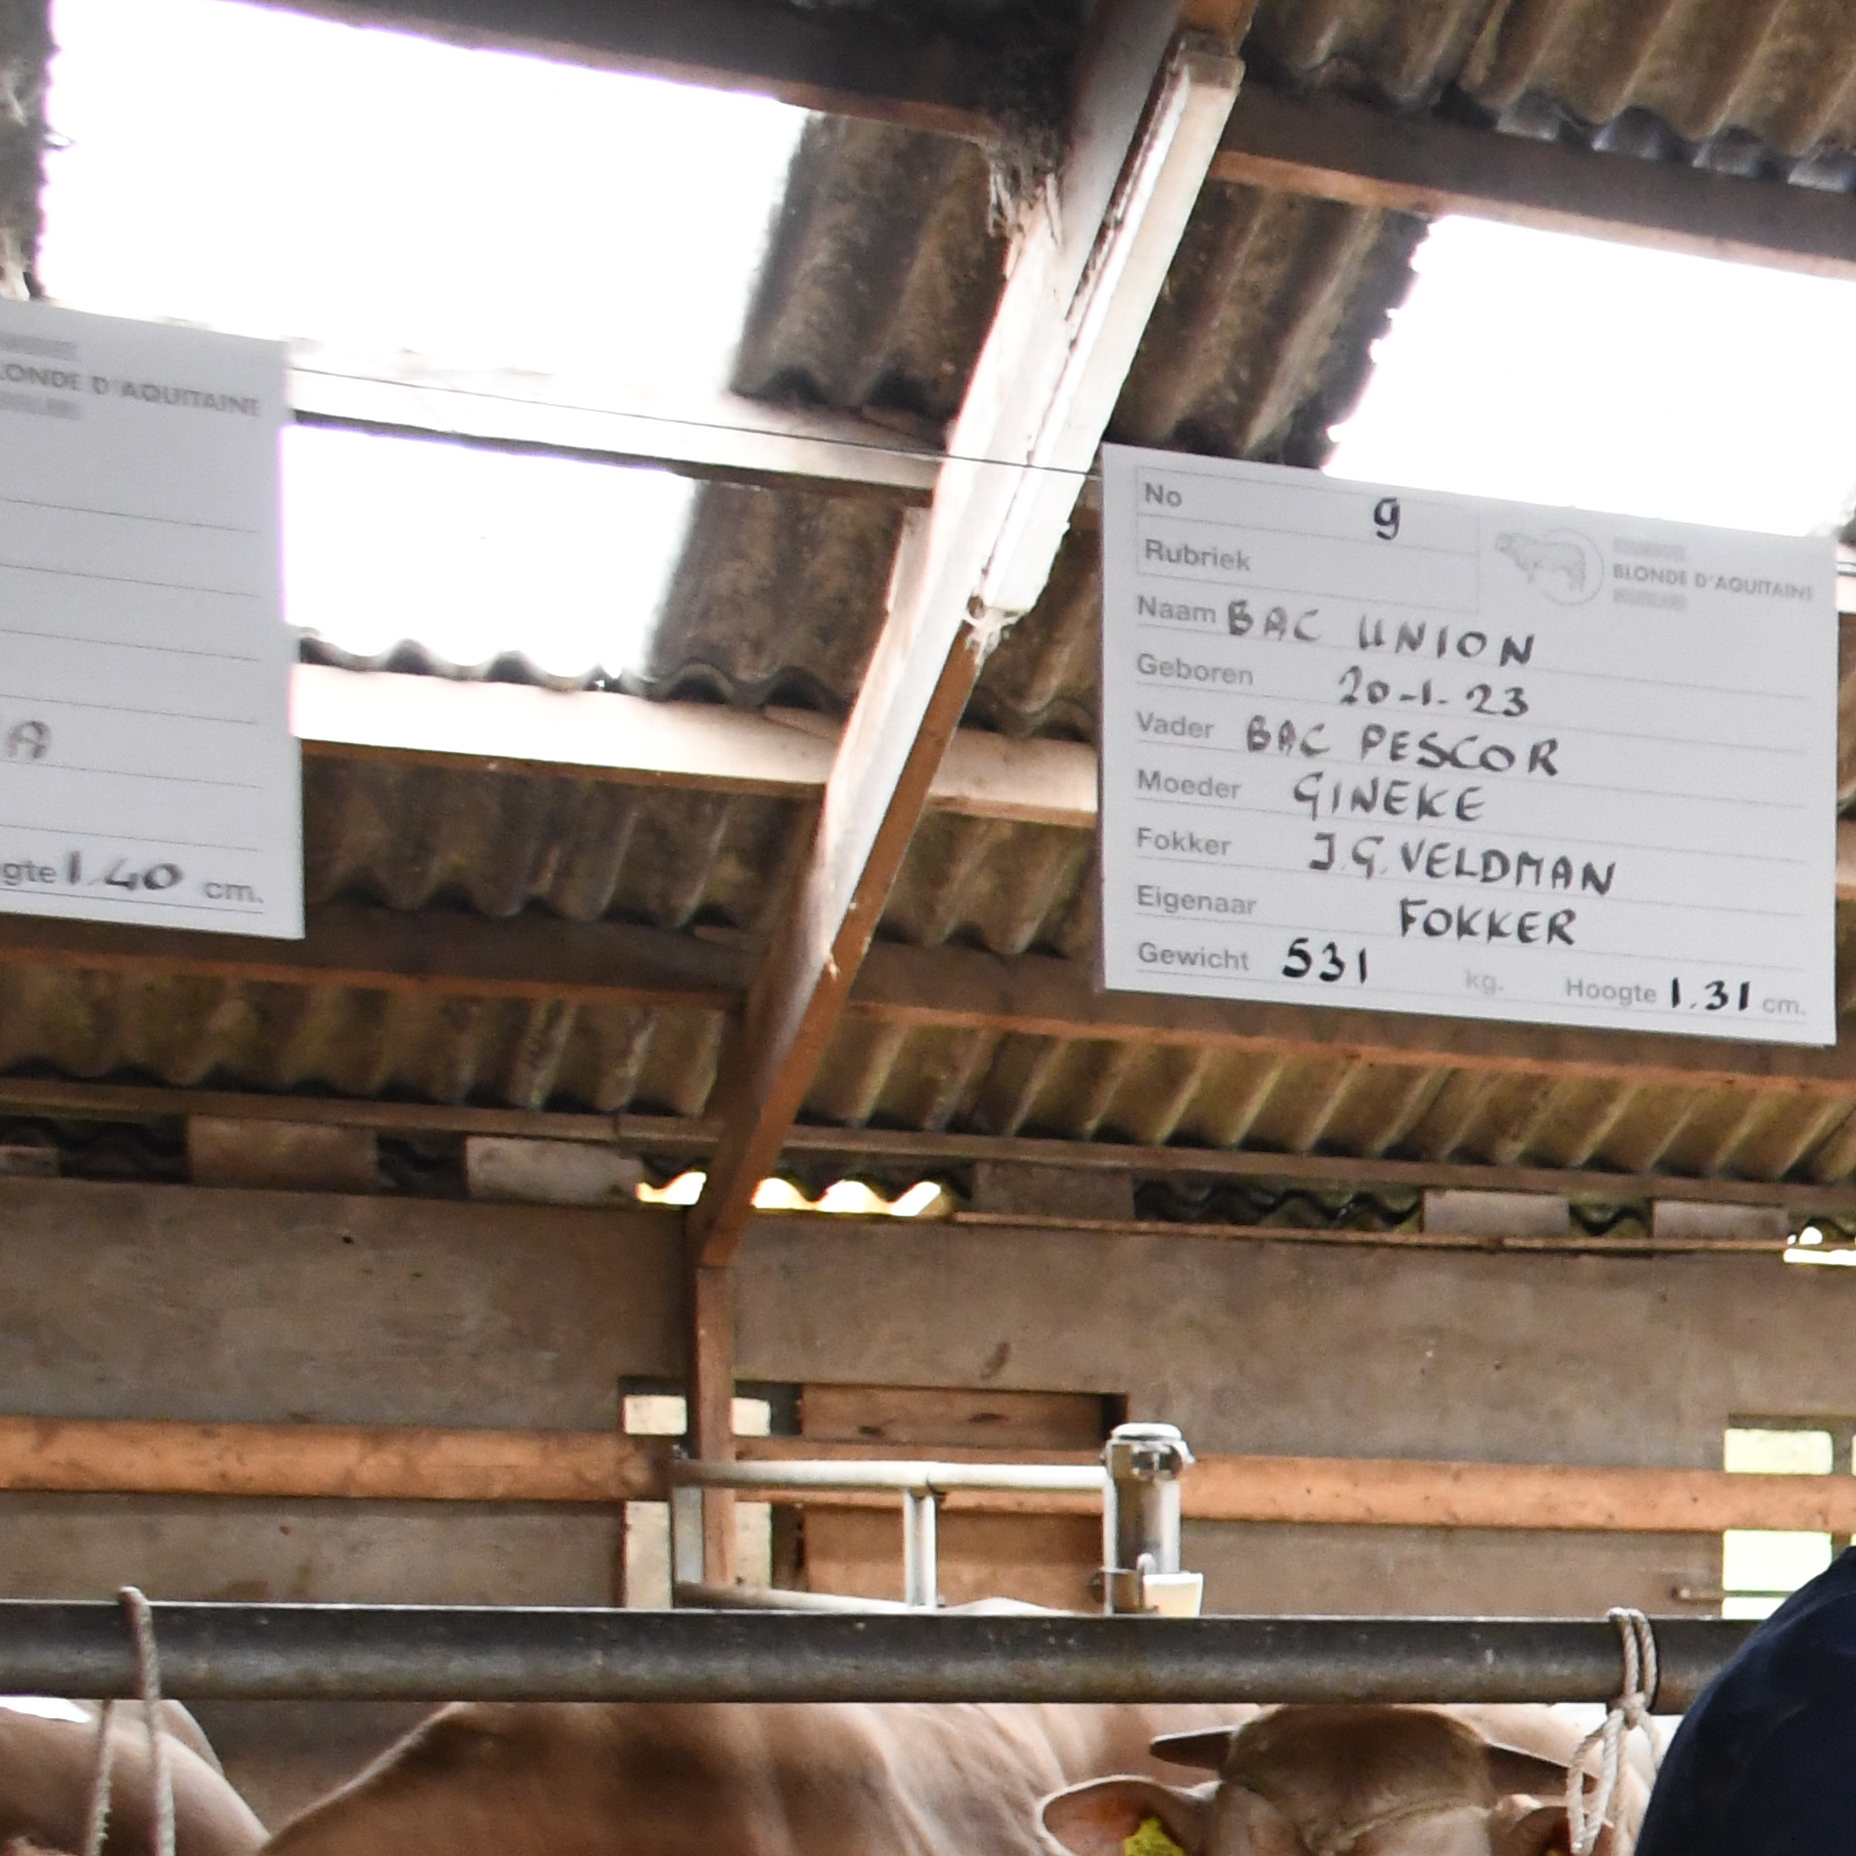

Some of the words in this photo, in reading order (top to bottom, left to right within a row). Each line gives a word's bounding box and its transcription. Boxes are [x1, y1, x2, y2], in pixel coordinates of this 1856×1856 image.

[0, 363, 81, 391] ONDE
[1144, 482, 1183, 508] No
[1144, 538, 1252, 572] Rubriek
[1613, 562, 1688, 587] BLONDE
[1136, 595, 1217, 624] Naam
[1227, 600, 1321, 642] BAC
[1358, 613, 1536, 668] UNION
[1136, 652, 1254, 687] Geboren
[1136, 711, 1215, 740] Vader
[1246, 714, 1331, 758] BAC
[1360, 722, 1561, 776] PESCOR
[1136, 768, 1243, 800] Moeder
[1293, 771, 1487, 822] GINEKE
[1136, 827, 1232, 858] Fokker
[1400, 838, 1618, 897] VELDMAN
[203, 881, 265, 904] cm.
[1136, 884, 1258, 917] Eigenaar
[1399, 896, 1579, 946] FOKKER
[1138, 943, 1251, 972] Gewicht
[1281, 937, 1369, 985] 531
[1465, 968, 1505, 996] kg.
[1565, 977, 1658, 1007] Hoogte
[1761, 997, 1808, 1016] cm.
